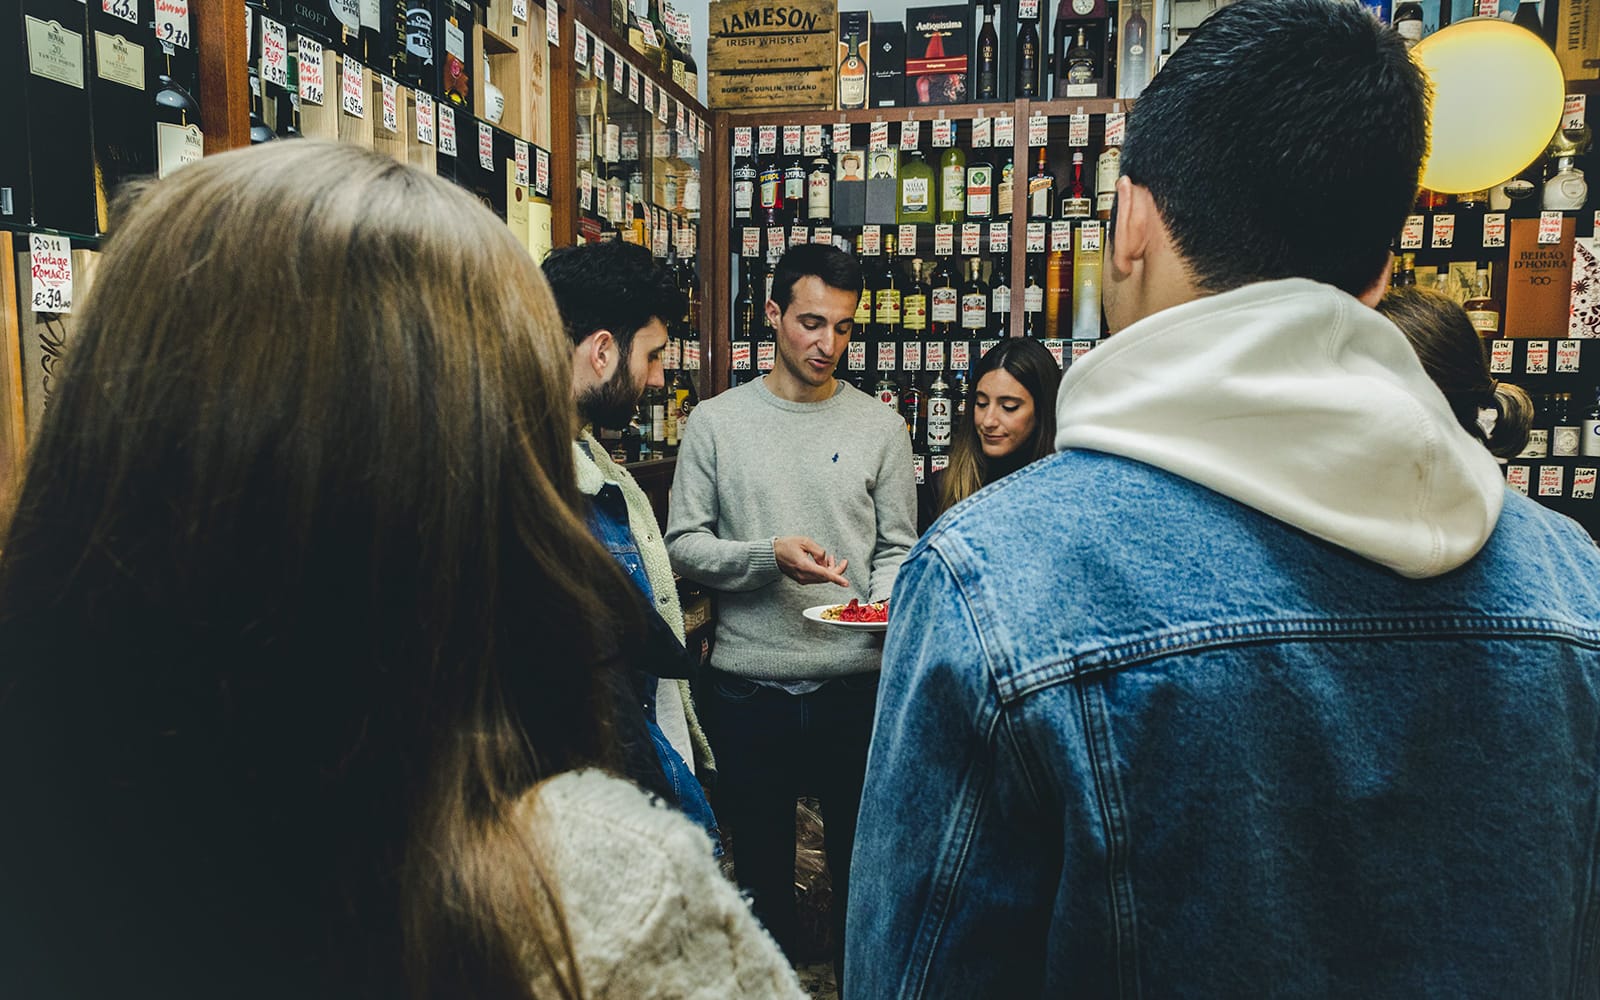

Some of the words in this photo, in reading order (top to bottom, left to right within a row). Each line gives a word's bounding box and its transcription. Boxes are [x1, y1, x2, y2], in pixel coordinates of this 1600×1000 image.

[296, 3, 329, 26] CROFT
[720, 7, 818, 34] JAMESON
[726, 39, 756, 47] IRISH
[759, 36, 809, 46] WHISKEY
[34, 236, 61, 252] 2011
[33, 253, 69, 272] Vintage
[1530, 276, 1552, 286] 100
[1562, 341, 1576, 349] GIN
